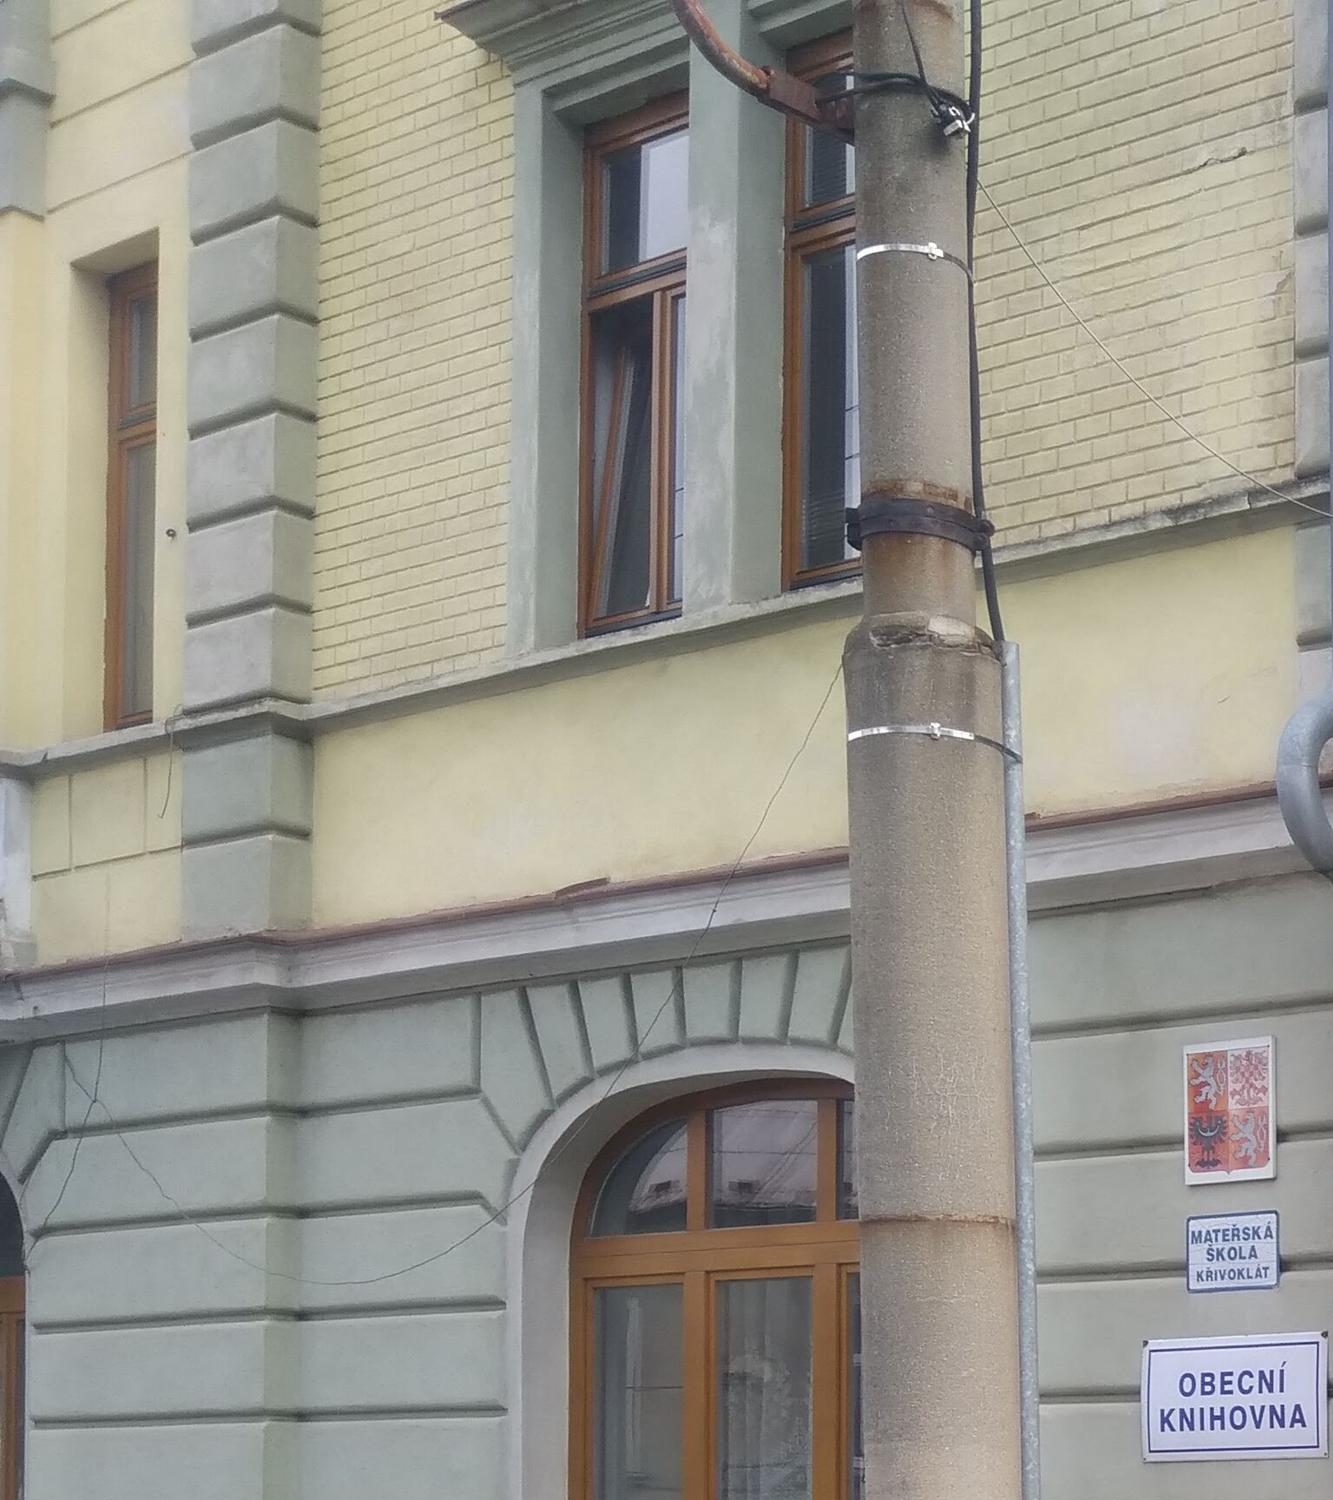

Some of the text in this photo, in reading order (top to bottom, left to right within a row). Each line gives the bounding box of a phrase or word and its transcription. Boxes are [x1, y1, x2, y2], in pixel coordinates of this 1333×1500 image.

[1191, 1221, 1274, 1245] MATEŘSKÁ
[1206, 1244, 1258, 1262] ŠKOLA
[1196, 1264, 1270, 1282] KŘIVOKLÁT
[1178, 1361, 1287, 1397] OBECNÍ
[1160, 1403, 1307, 1433] KNIHOVNA
